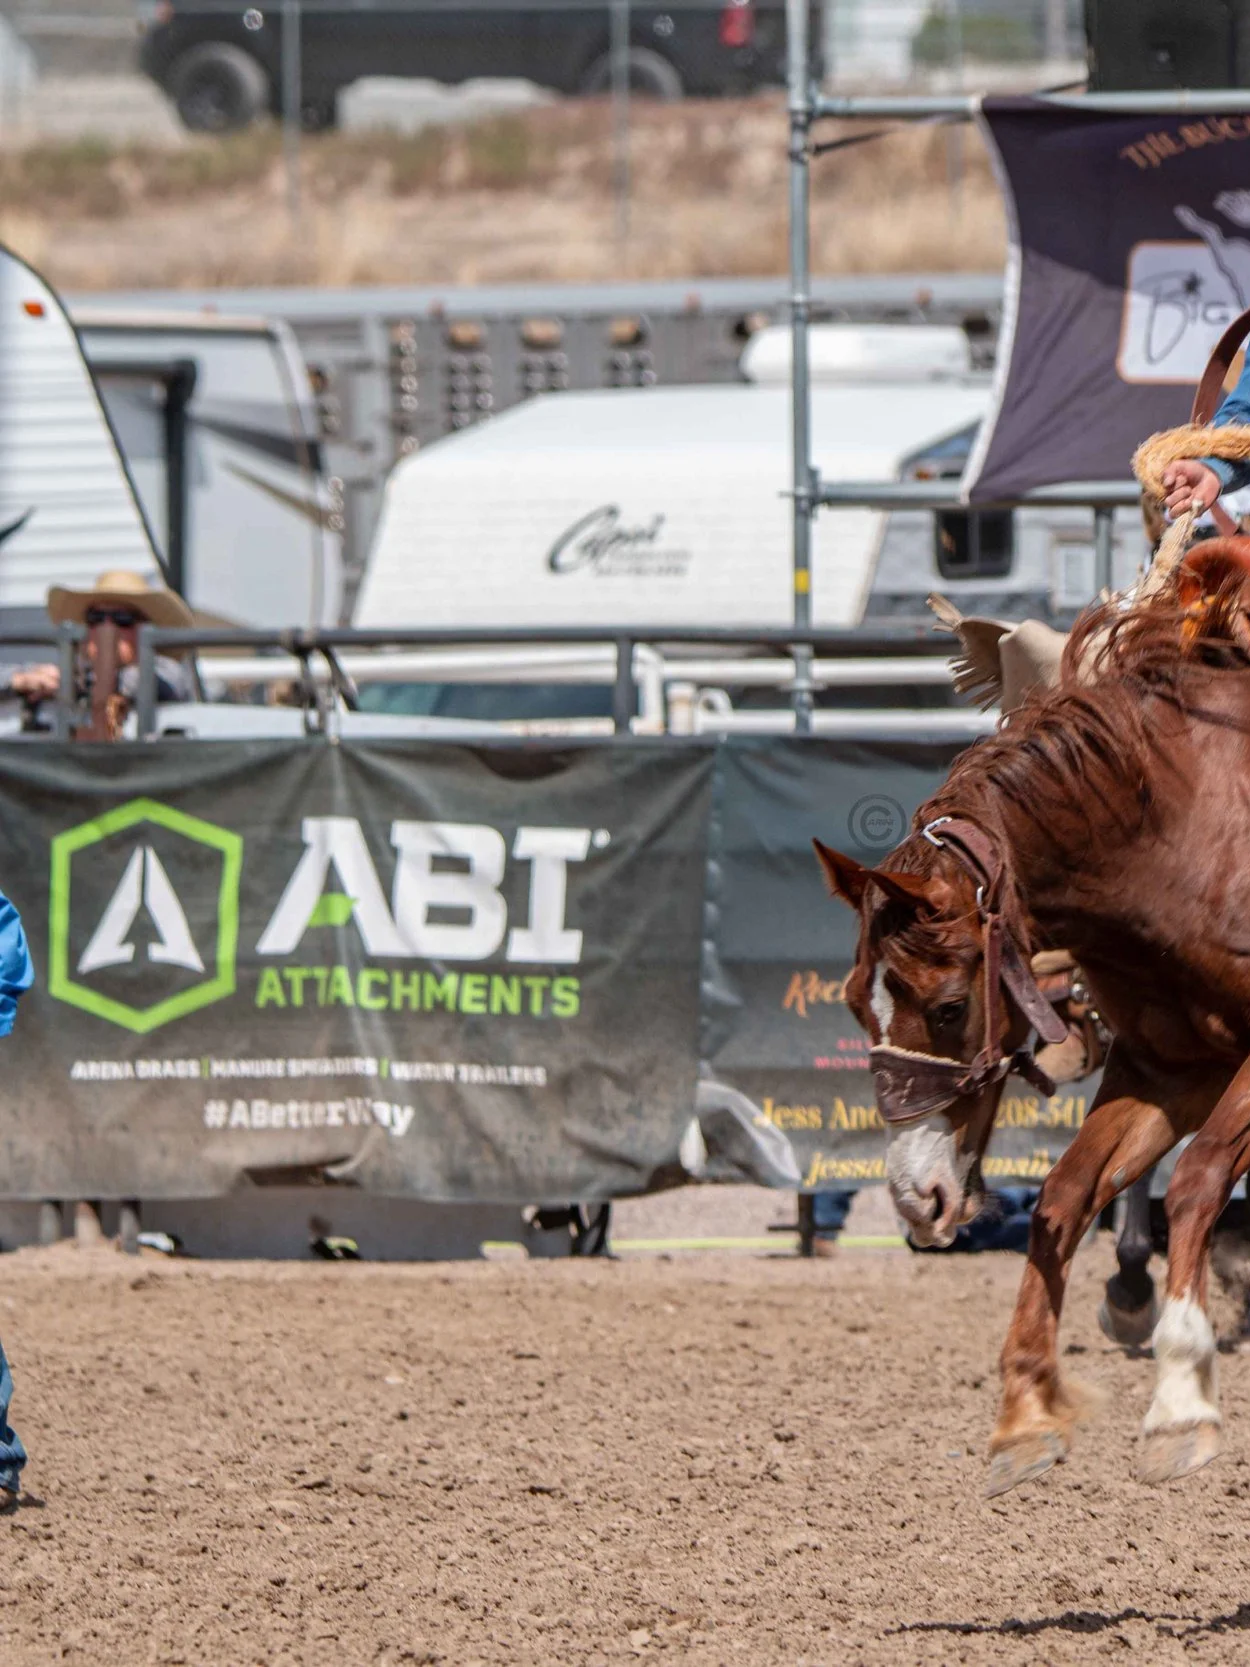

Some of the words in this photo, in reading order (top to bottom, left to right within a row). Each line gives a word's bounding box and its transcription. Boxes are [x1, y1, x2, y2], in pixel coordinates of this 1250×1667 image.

[255, 816, 592, 964] ABI
[254, 965, 581, 1018] ATTACHMENTS
[813, 1056, 871, 1069] MOUN
[803, 1151, 889, 1188] jessa
